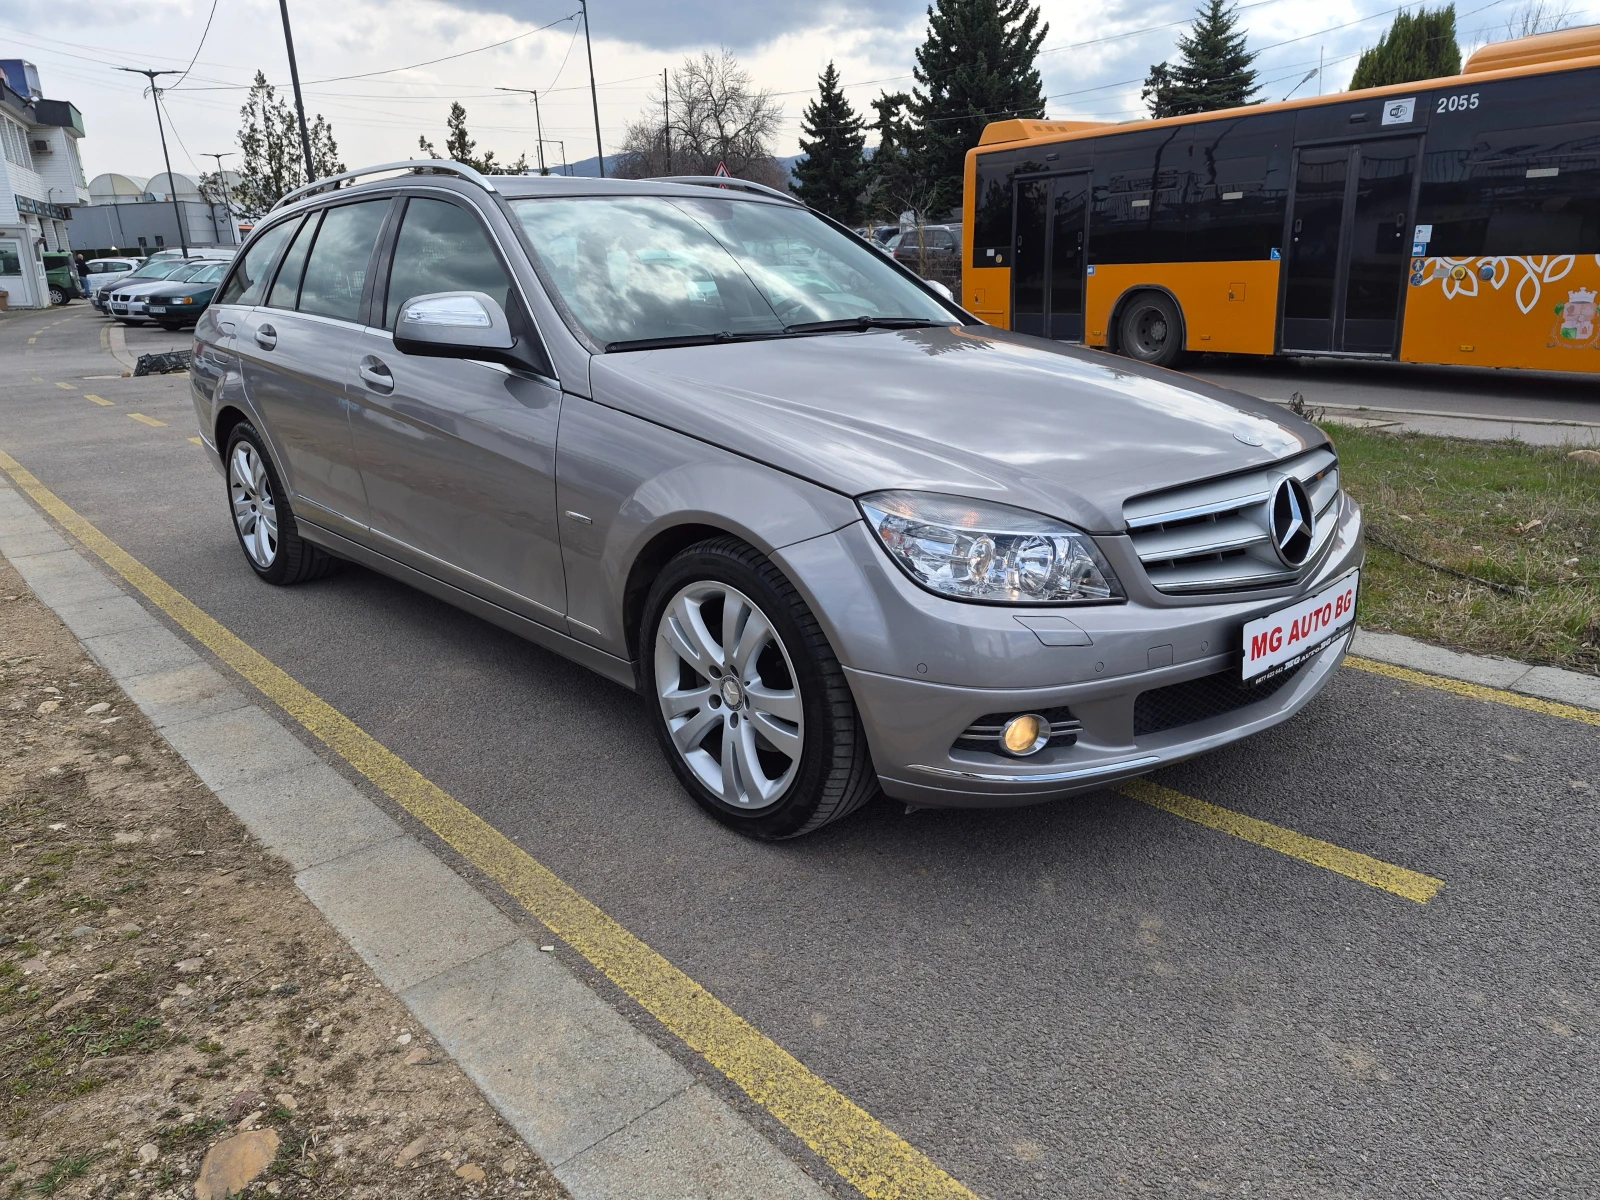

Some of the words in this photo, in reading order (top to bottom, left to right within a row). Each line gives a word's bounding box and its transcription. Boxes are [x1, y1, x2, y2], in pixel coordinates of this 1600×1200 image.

[1436, 93, 1479, 113] 2055
[1250, 626, 1283, 661] MG
[1287, 602, 1332, 646] AUTO
[1334, 589, 1352, 619] BG
